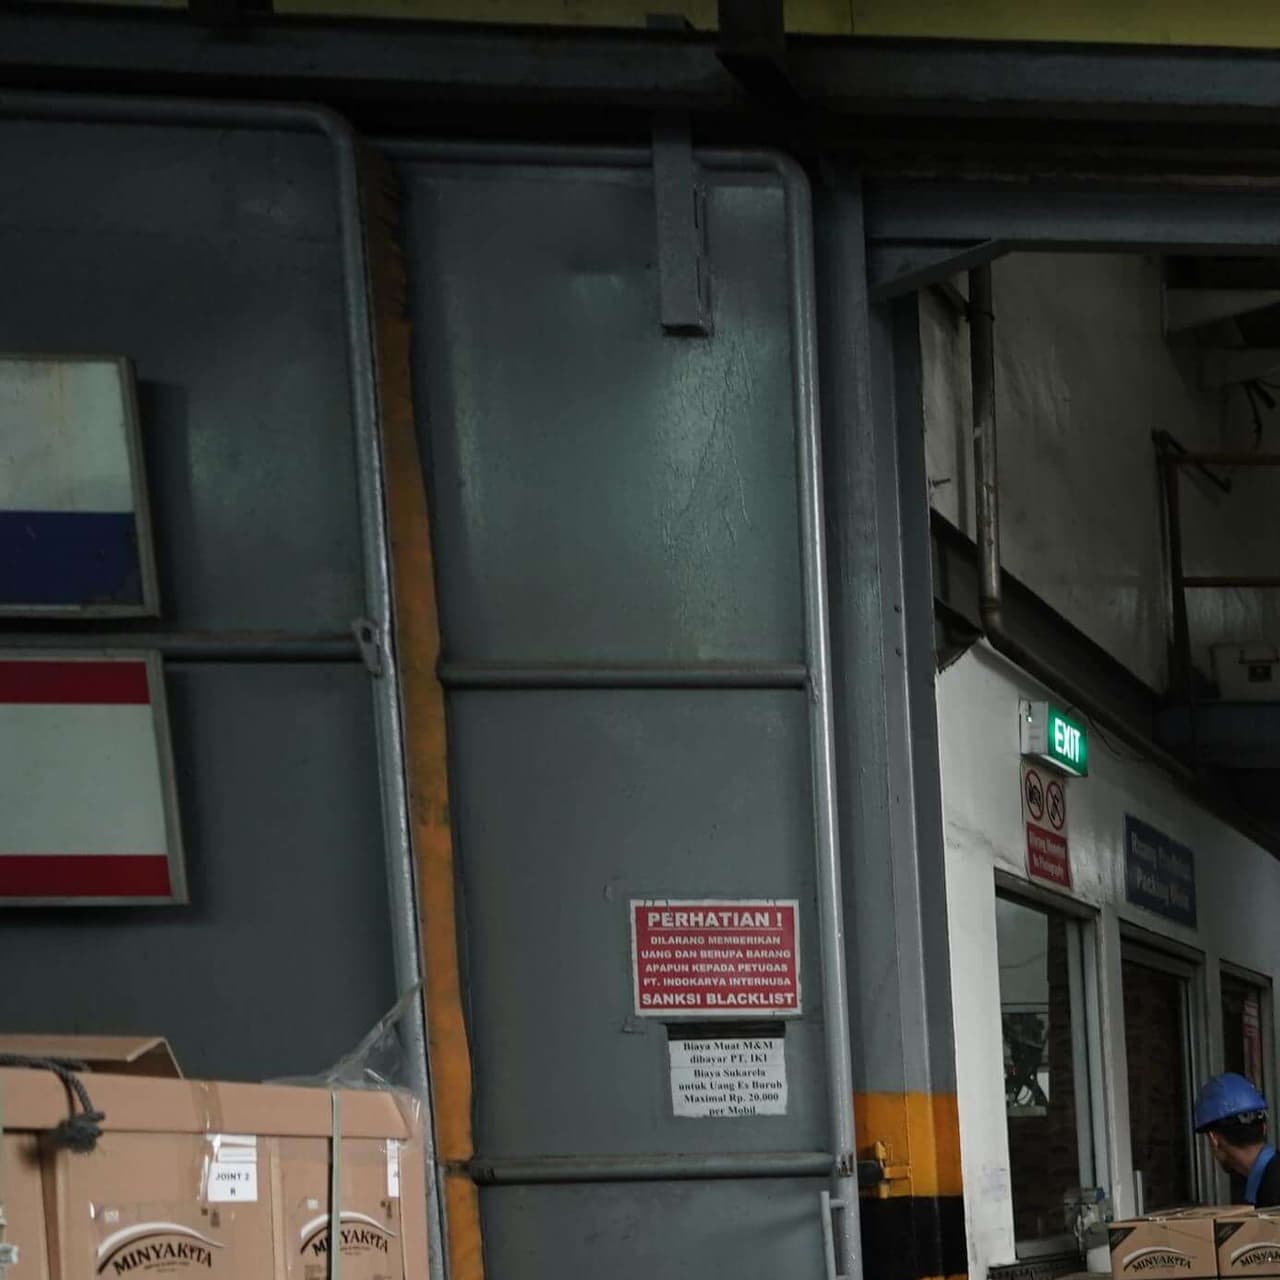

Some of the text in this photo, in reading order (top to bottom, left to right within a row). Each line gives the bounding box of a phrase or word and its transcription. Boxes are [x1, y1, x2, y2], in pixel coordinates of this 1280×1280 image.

[1054, 717, 1080, 763] EXIT
[648, 912, 782, 927] PERHATIAN !
[651, 936, 780, 945] DILARANG MEMBERIKAN
[642, 951, 671, 959] UANG
[646, 964, 787, 972] APAPUN KEPADA PETUGAS
[644, 978, 791, 986] PT. INDOKARYA INTERNUSA
[642, 993, 794, 1005] SANKSI BLACKLIST
[683, 1042, 710, 1052] Biaya
[714, 1042, 739, 1050] Muat
[690, 1055, 726, 1064] dibayar
[731, 1054, 747, 1063] PT.
[694, 1069, 765, 1078] Biaya Sukarela
[679, 1082, 706, 1090] untuk
[710, 1082, 735, 1092] Uang
[684, 1094, 726, 1103] Maximal
[729, 1094, 746, 1104] Rp.
[709, 1106, 755, 1116] per Mobil
[216, 1172, 251, 1182] JOINT 2
[112, 1242, 212, 1276] MINYAKITA
[1132, 1257, 1191, 1273] MINYAKITA
